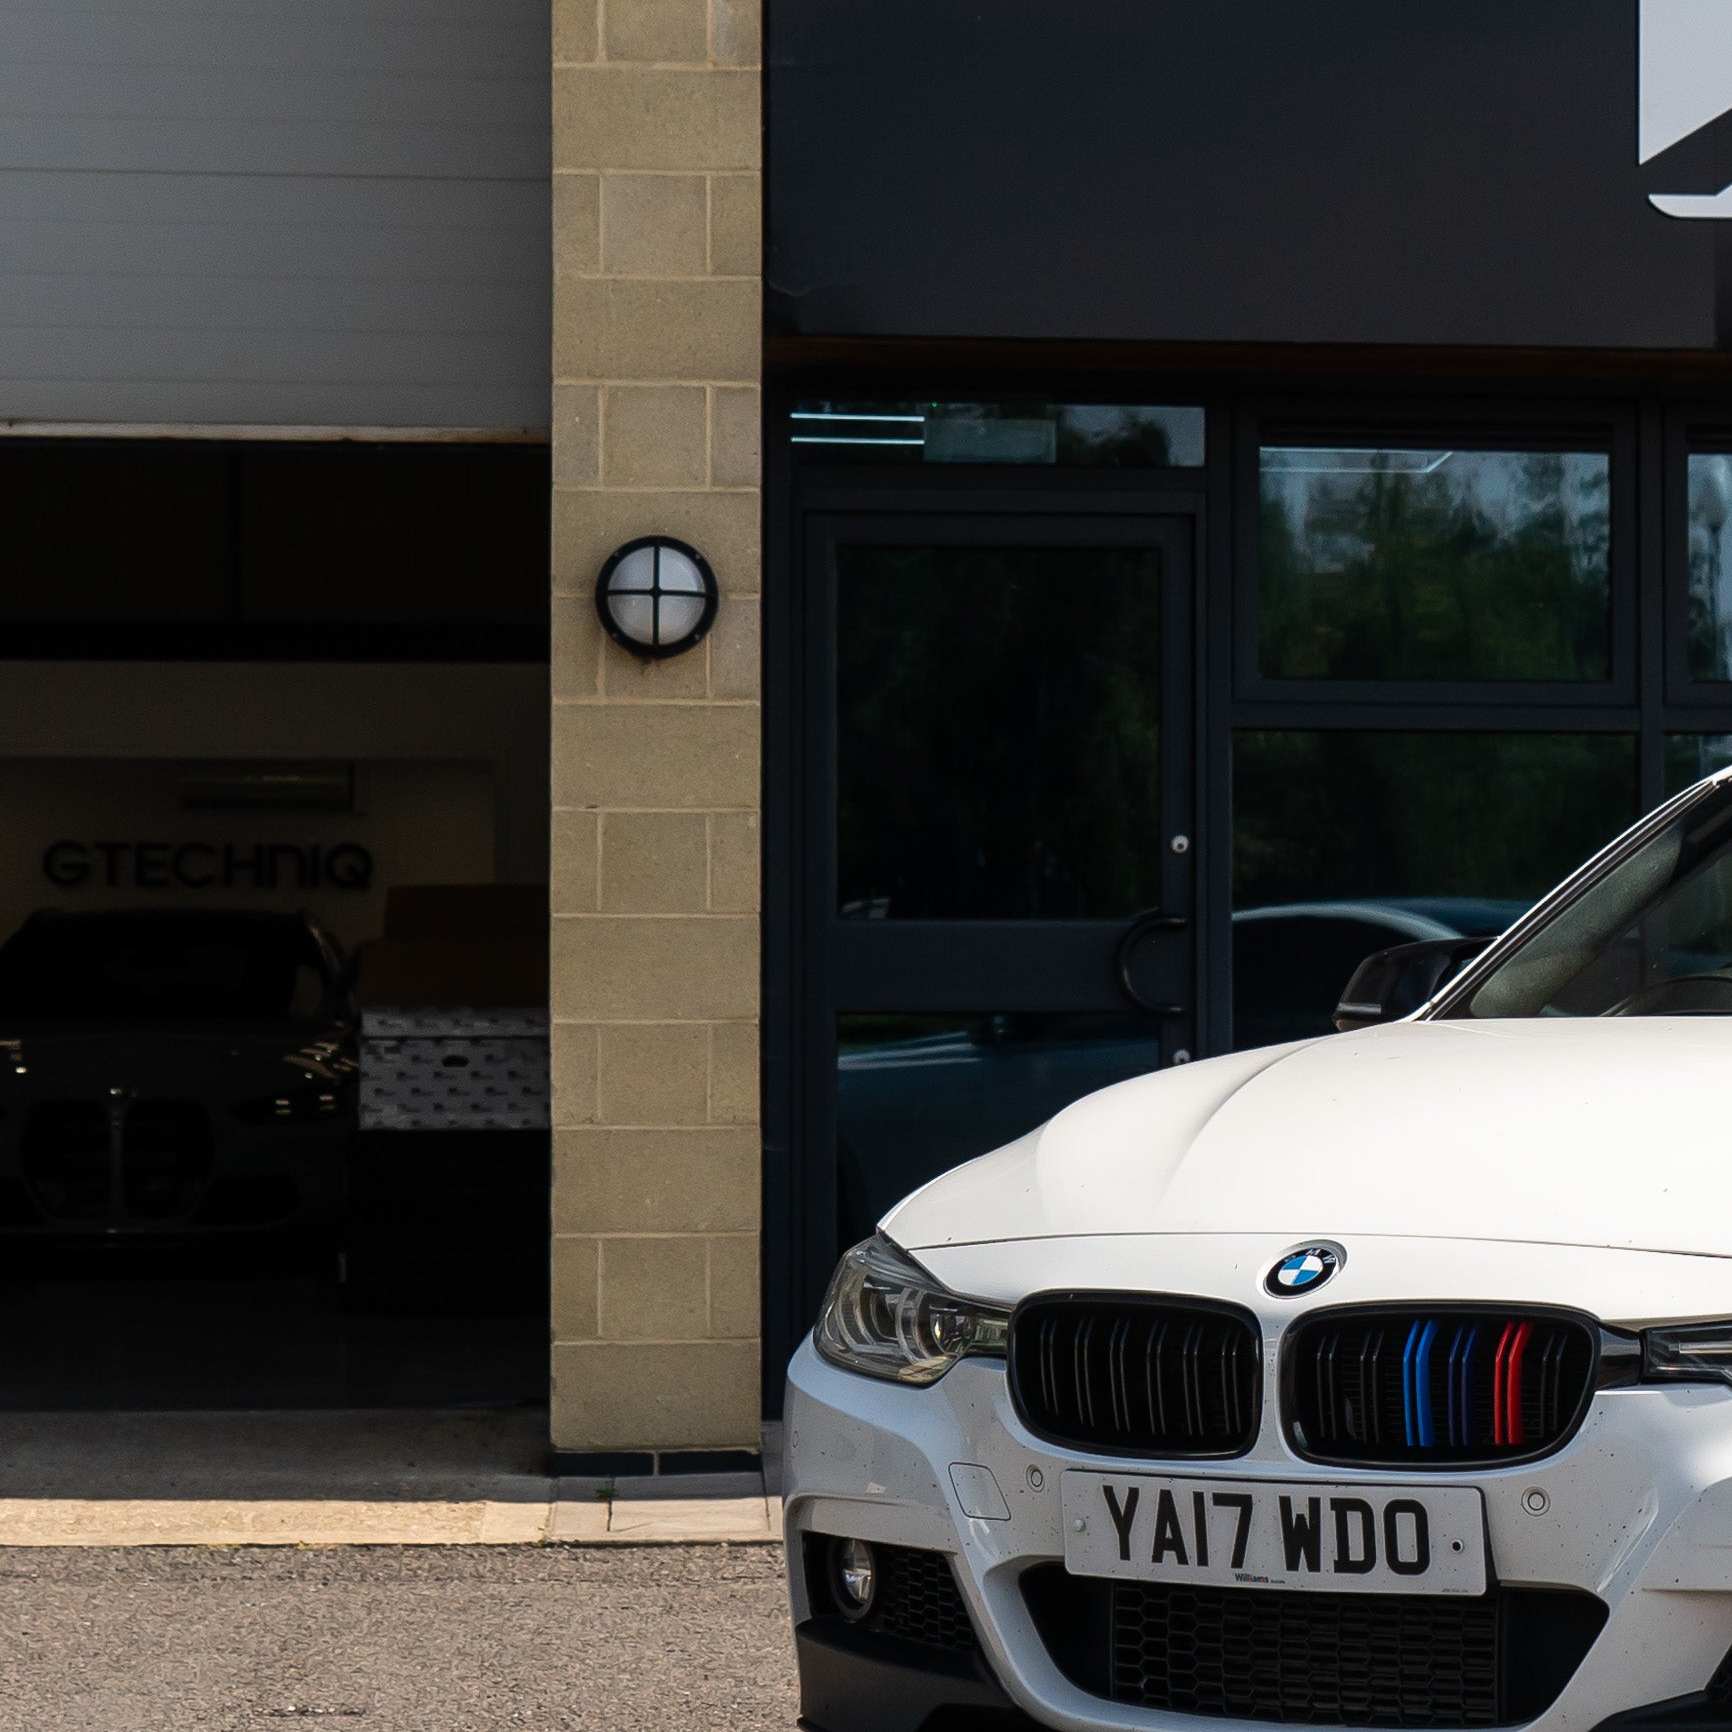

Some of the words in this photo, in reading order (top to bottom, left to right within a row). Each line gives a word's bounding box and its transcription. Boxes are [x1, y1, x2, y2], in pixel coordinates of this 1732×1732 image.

[42, 840, 375, 890] GTECHNIQ
[1102, 1484, 1254, 1569] YA17
[1278, 1494, 1431, 1576] WDO
